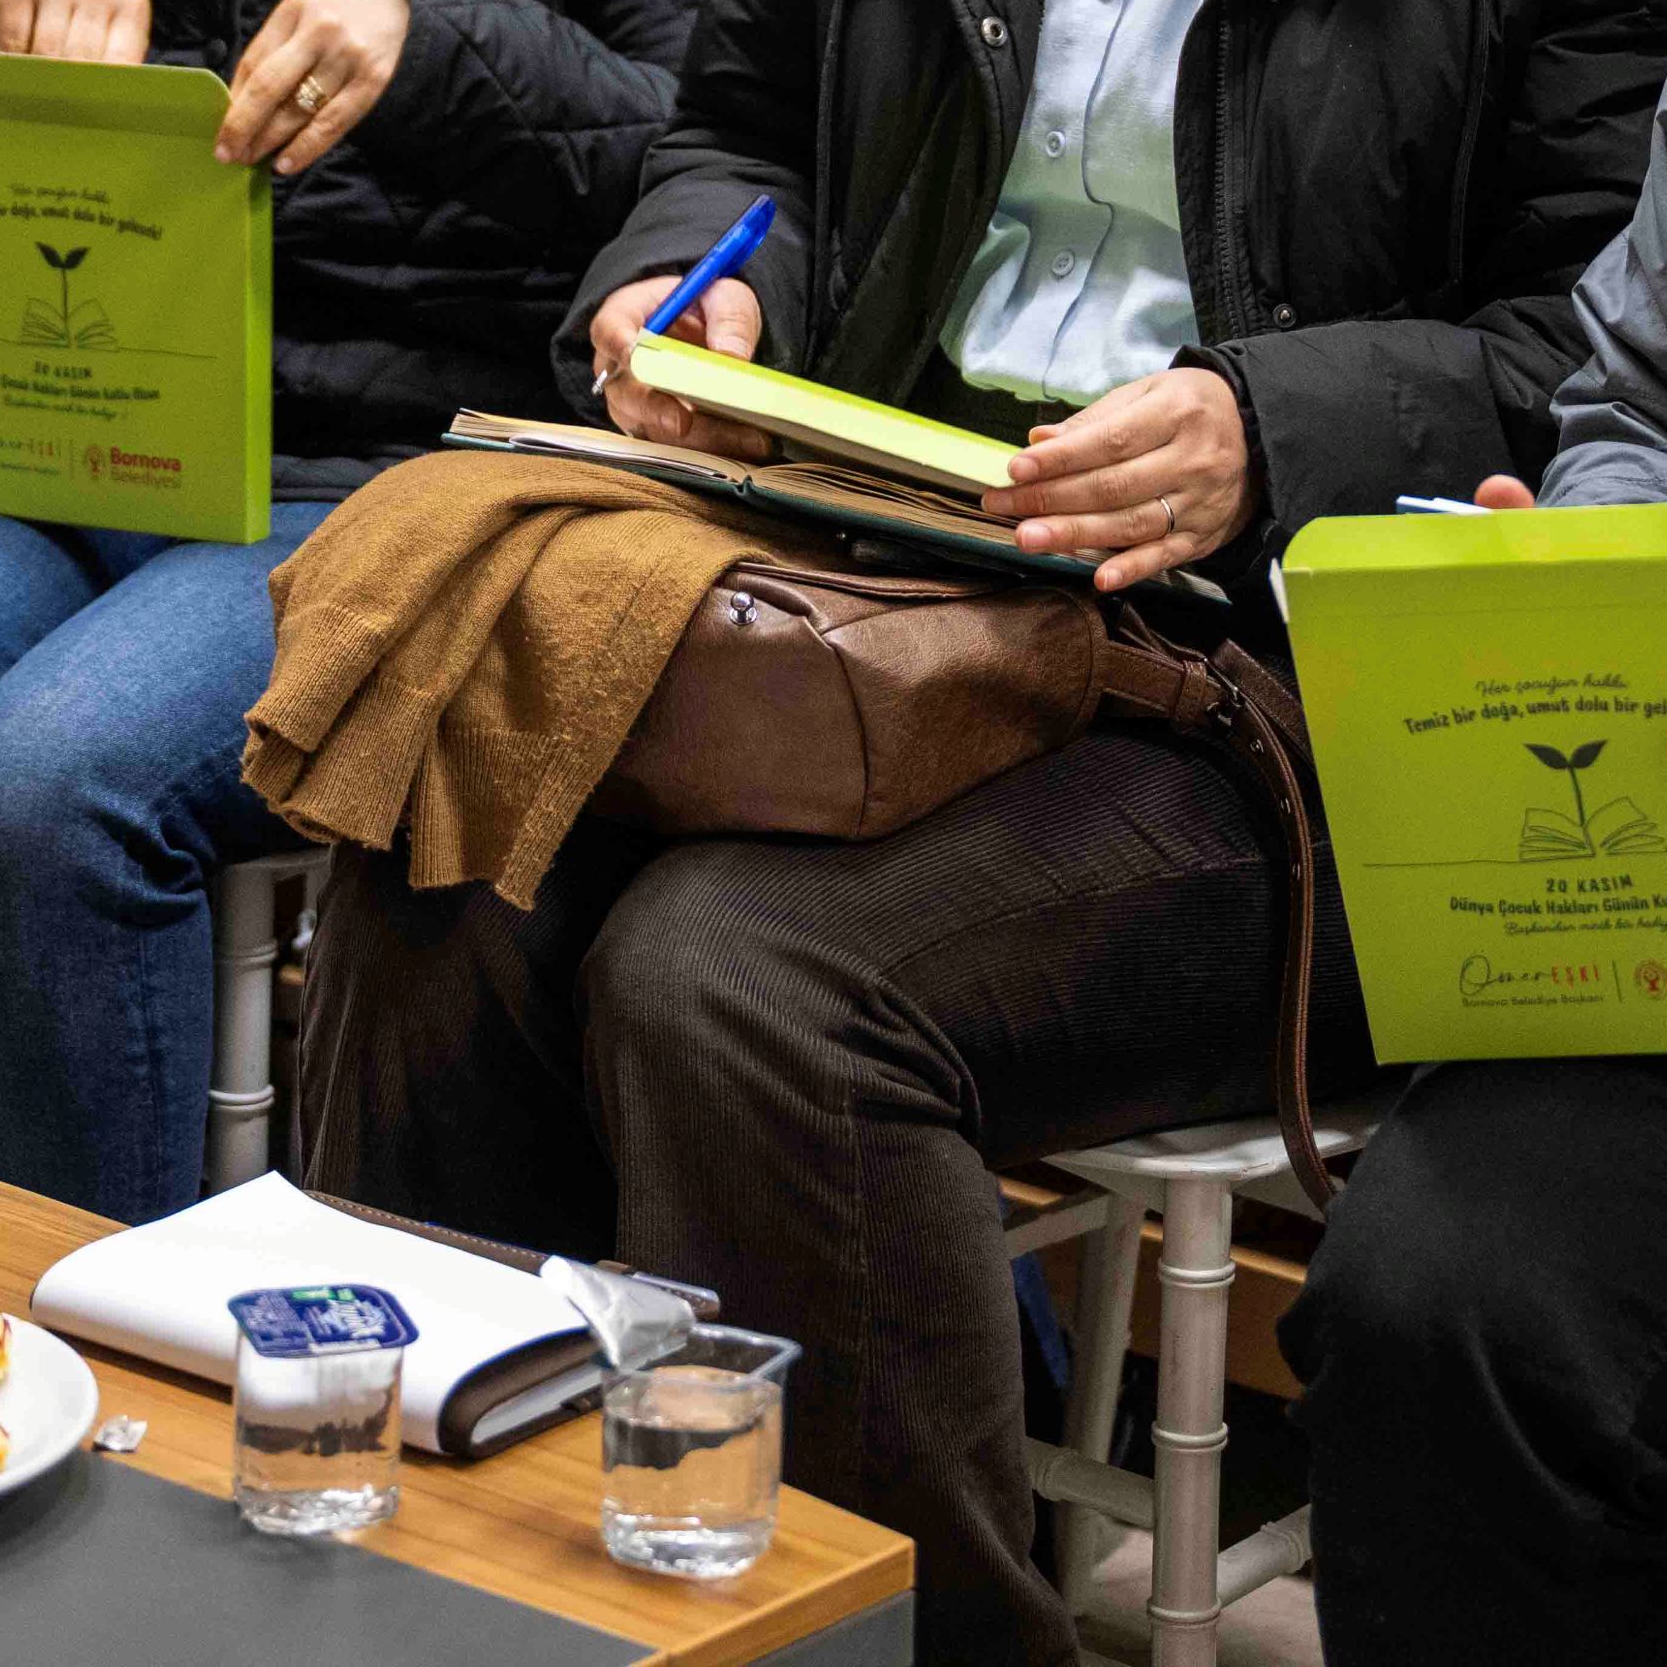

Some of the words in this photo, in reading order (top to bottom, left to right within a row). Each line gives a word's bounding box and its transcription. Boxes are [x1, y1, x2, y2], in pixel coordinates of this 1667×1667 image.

[109, 445, 183, 473] Bornova
[1403, 711, 1451, 735] Temiz
[1451, 706, 1476, 724] bir
[1480, 700, 1525, 722] doğa,
[1526, 699, 1571, 715] umut
[1575, 694, 1609, 713] dolu
[1614, 695, 1638, 713] bir
[1546, 877, 1568, 893] 20
[1577, 873, 1634, 894] KASIM
[1449, 895, 1495, 916] Dünya
[1498, 898, 1542, 917] Çocuk
[1545, 899, 1599, 915] Hakları
